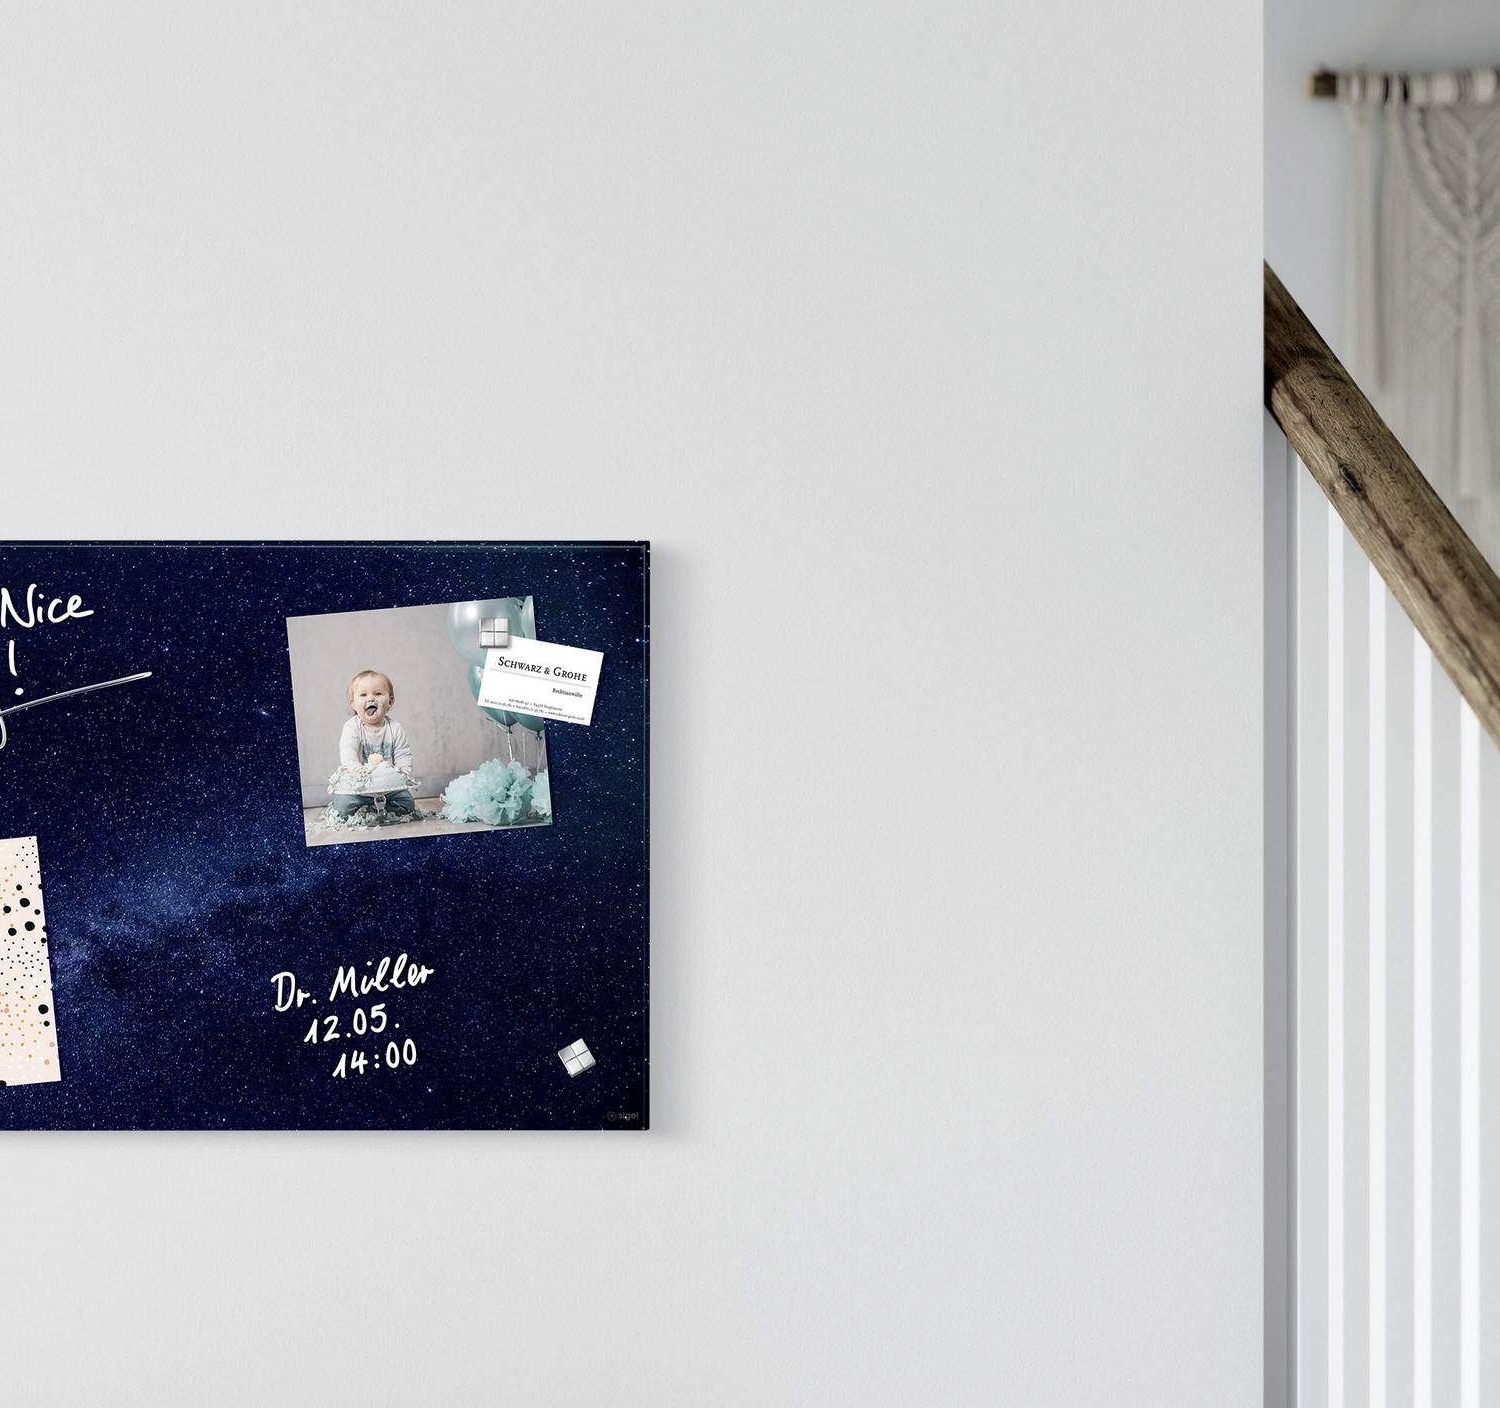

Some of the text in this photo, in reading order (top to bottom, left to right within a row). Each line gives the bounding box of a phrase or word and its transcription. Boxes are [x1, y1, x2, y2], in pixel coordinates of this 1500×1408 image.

[0, 583, 95, 629] Nice
[543, 667, 551, 675] &
[270, 971, 317, 1012] Dr.
[303, 1003, 400, 1044] 12.05.
[332, 1038, 417, 1079] 14:00
